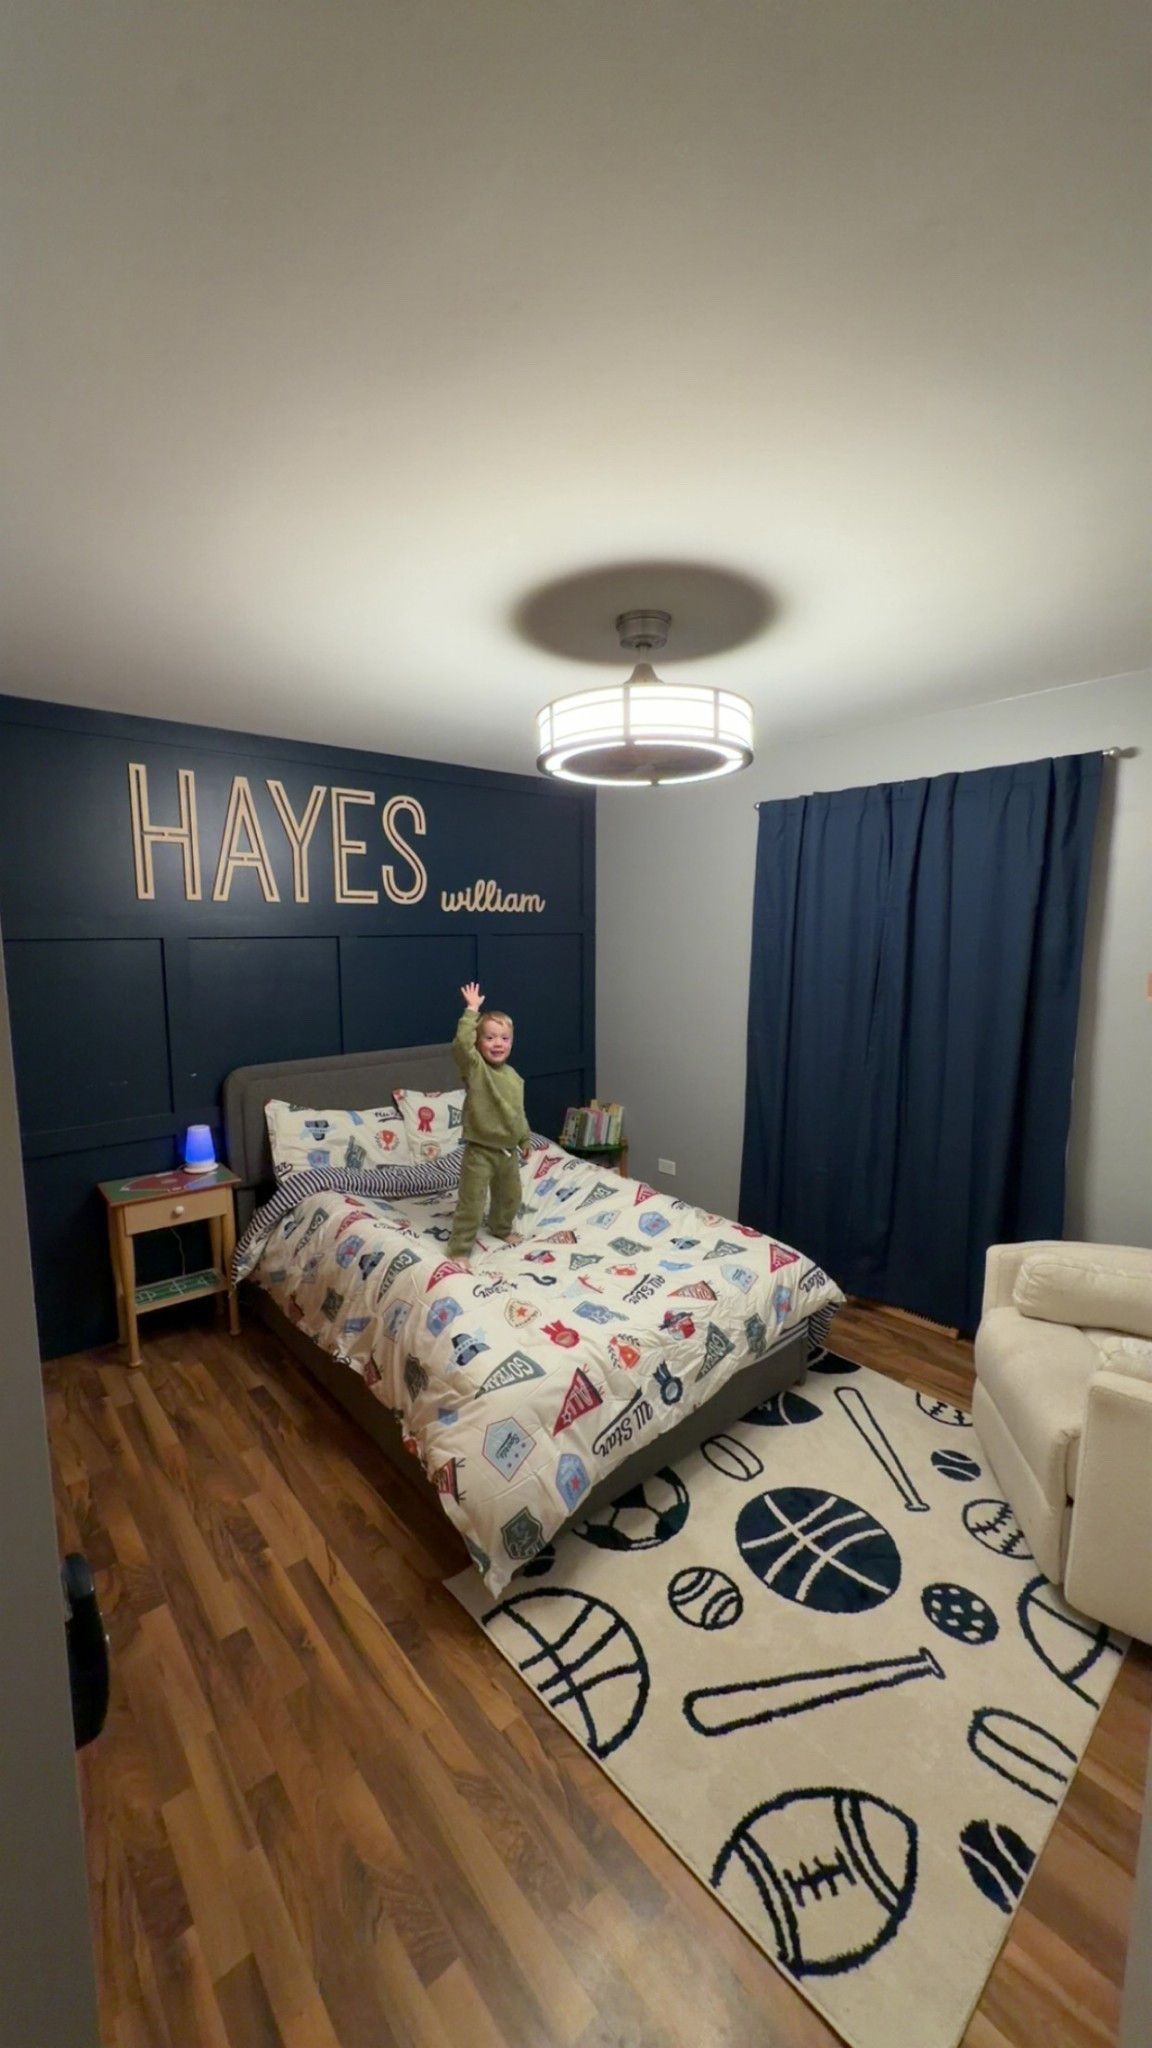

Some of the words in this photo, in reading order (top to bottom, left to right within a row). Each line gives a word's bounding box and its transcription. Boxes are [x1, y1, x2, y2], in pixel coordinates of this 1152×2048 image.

[128, 763, 426, 904] HAYES
[441, 879, 546, 912] william
[482, 1367, 515, 1392] TEAM
[507, 1357, 535, 1378] GO
[567, 1374, 595, 1416] ALL
[592, 1418, 633, 1457] Star
